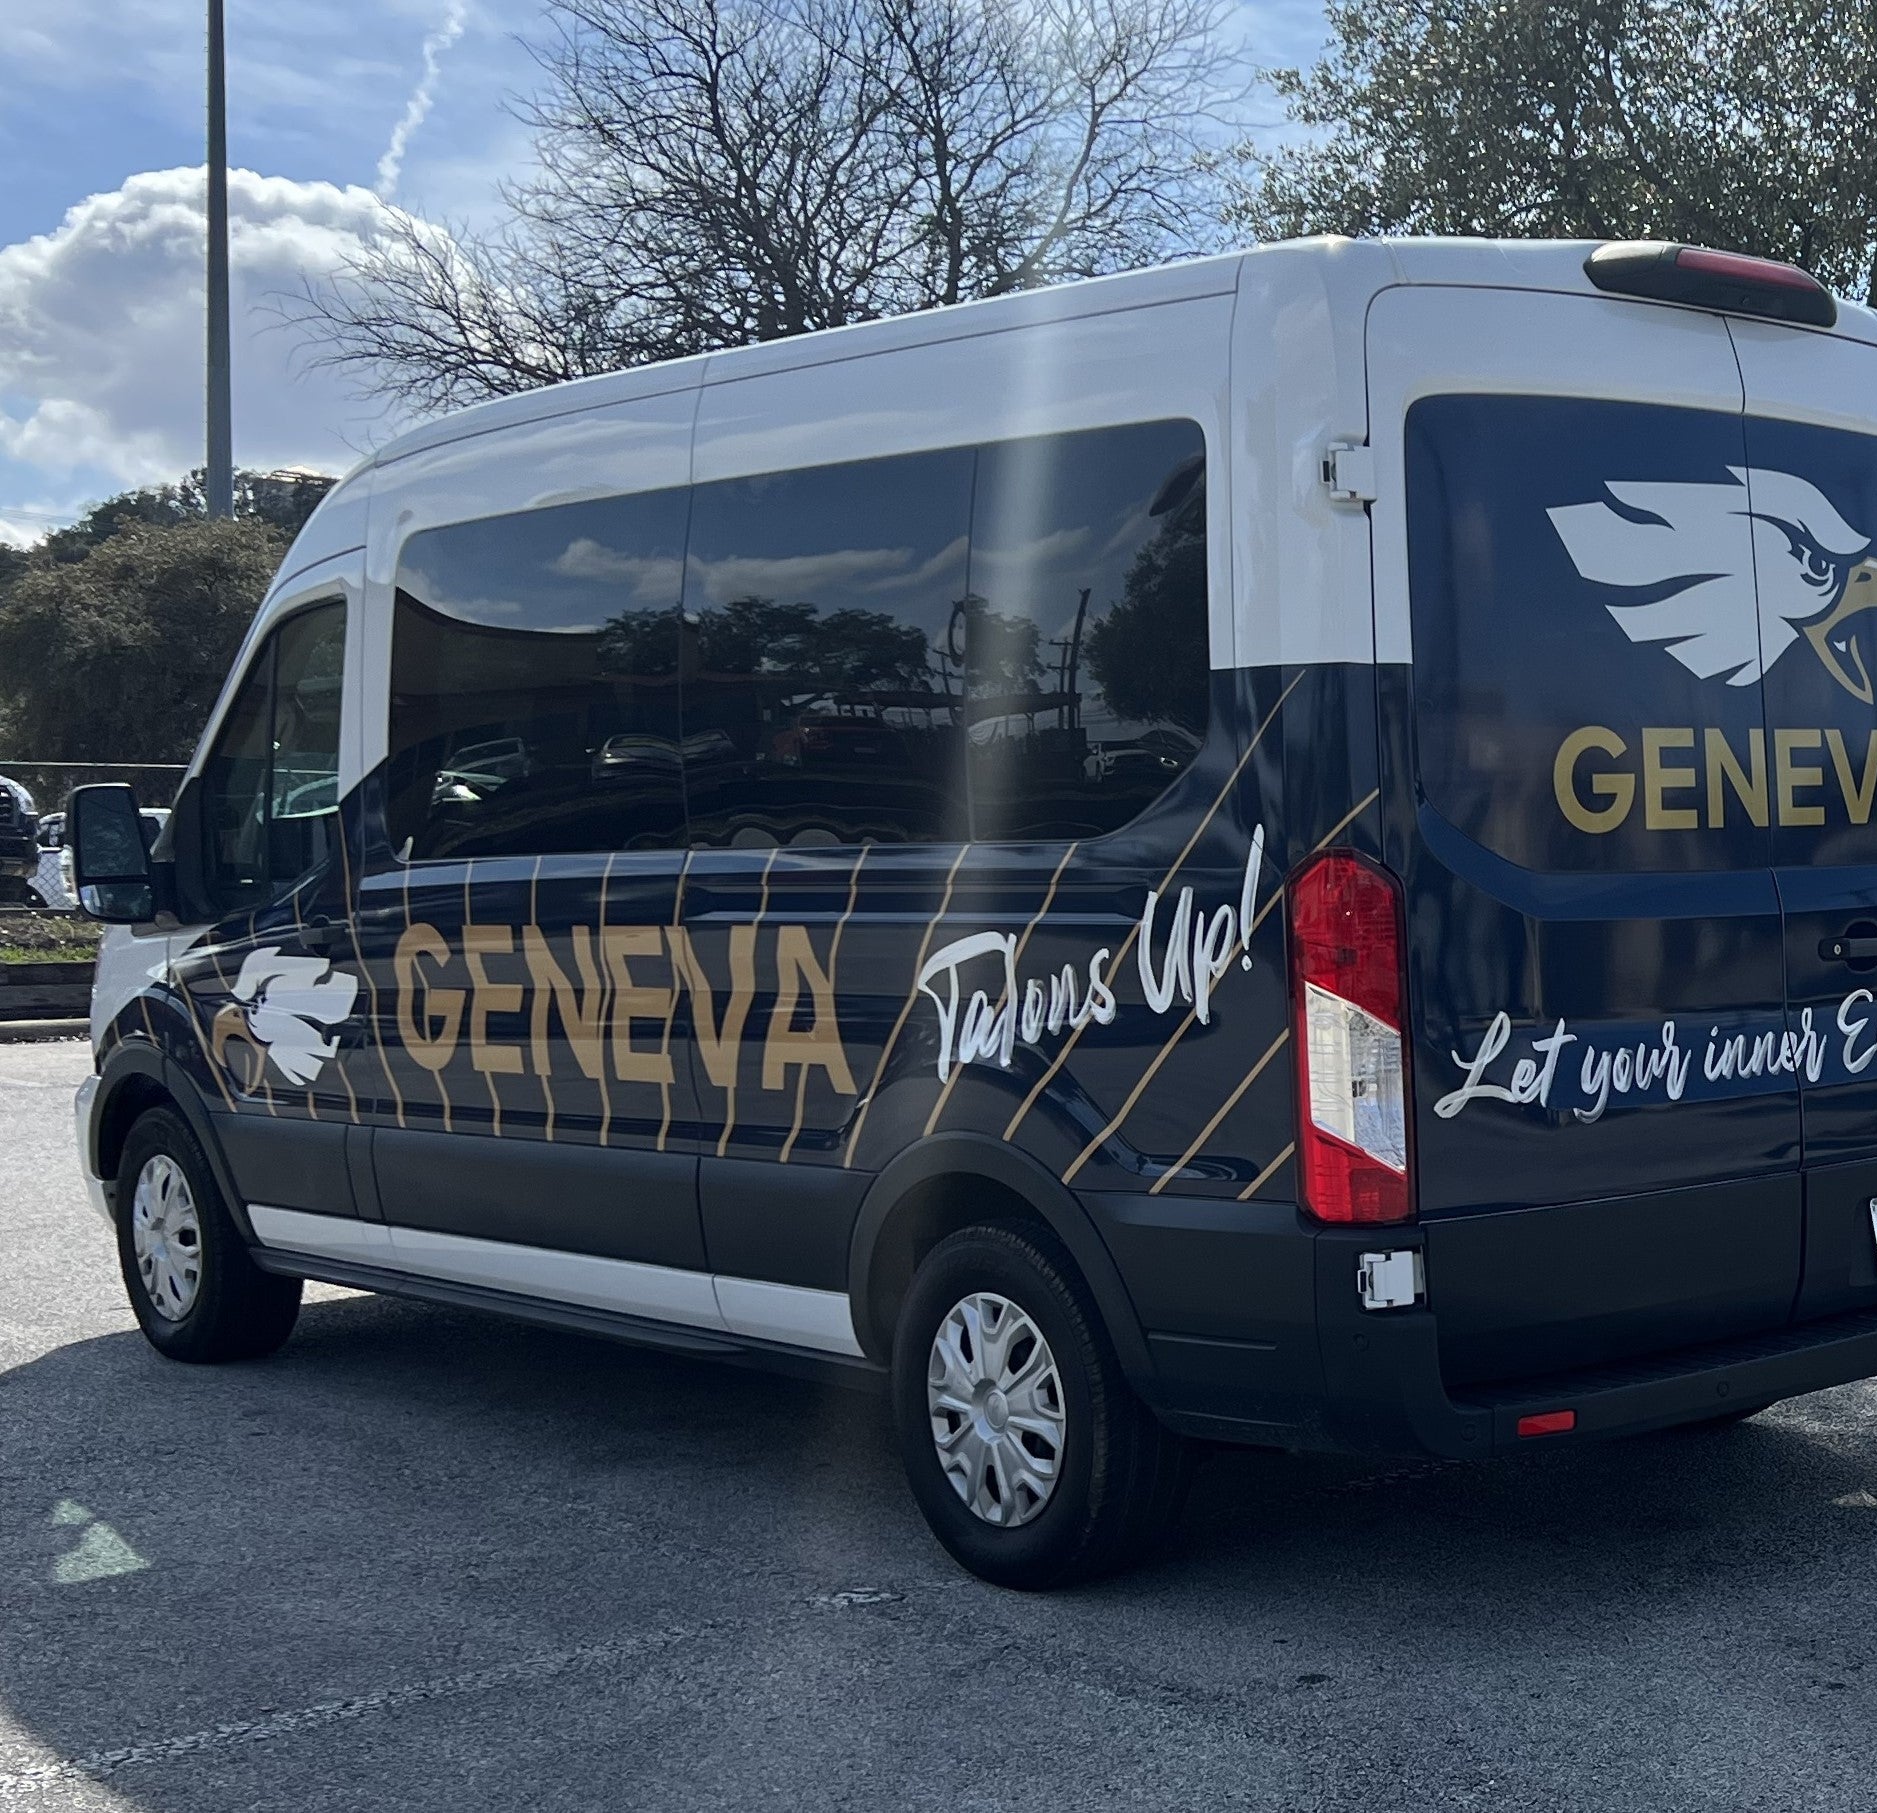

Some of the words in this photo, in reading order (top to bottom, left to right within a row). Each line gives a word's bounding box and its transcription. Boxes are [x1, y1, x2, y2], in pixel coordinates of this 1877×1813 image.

[394, 921, 858, 1095] GENEVA
[917, 930, 1116, 1084] Talons
[1137, 822, 1266, 1026] Up!
[1433, 1010, 1578, 1119] Let
[1573, 1020, 1692, 1124] your
[1703, 1007, 1827, 1083] inner
